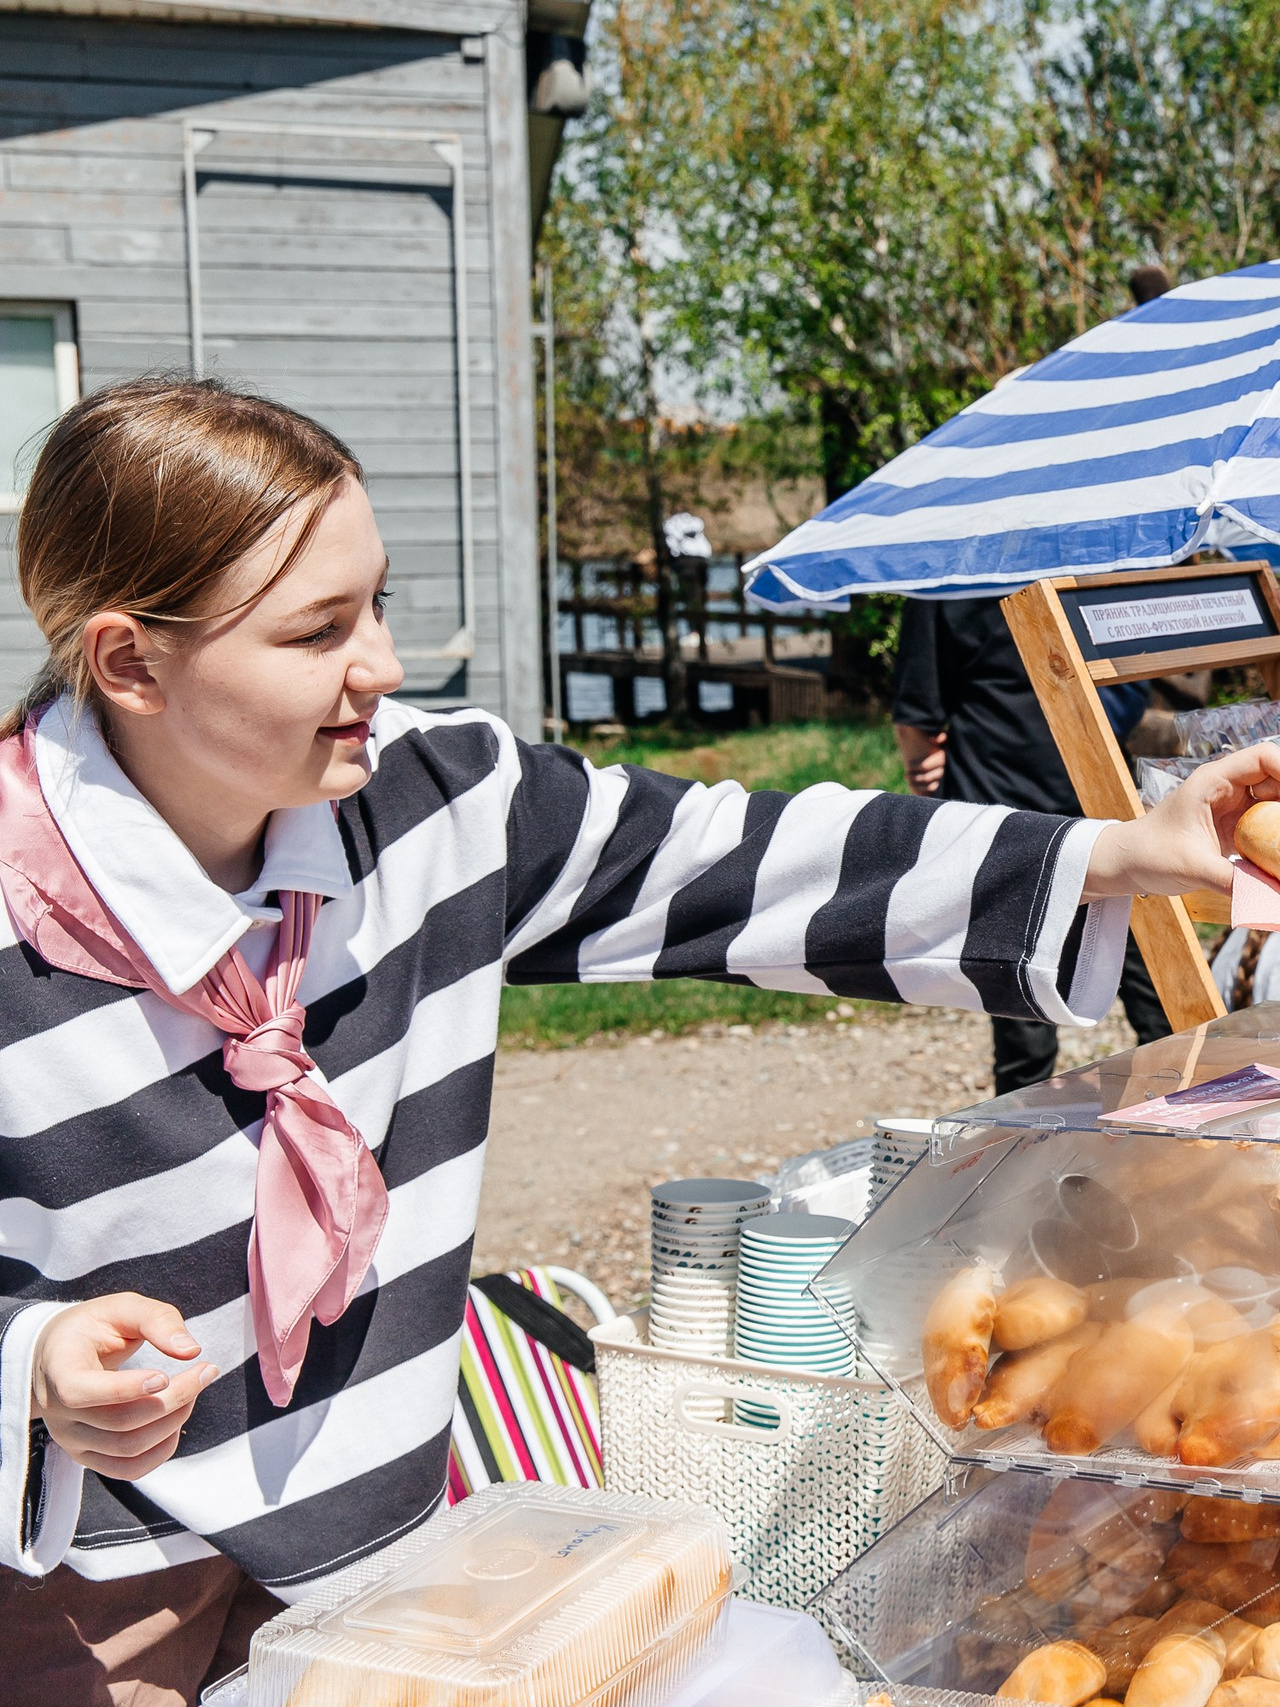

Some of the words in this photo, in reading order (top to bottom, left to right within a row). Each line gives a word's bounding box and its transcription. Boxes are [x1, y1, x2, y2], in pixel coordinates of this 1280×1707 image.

[1092, 607, 1130, 620] ПРЯНИК
[1130, 597, 1201, 616] ТРАДИЦИОННЫЙ
[1201, 592, 1247, 609] ПЕЧАТНЫЙ
[1201, 609, 1246, 627] НАЧИНКОЙ
